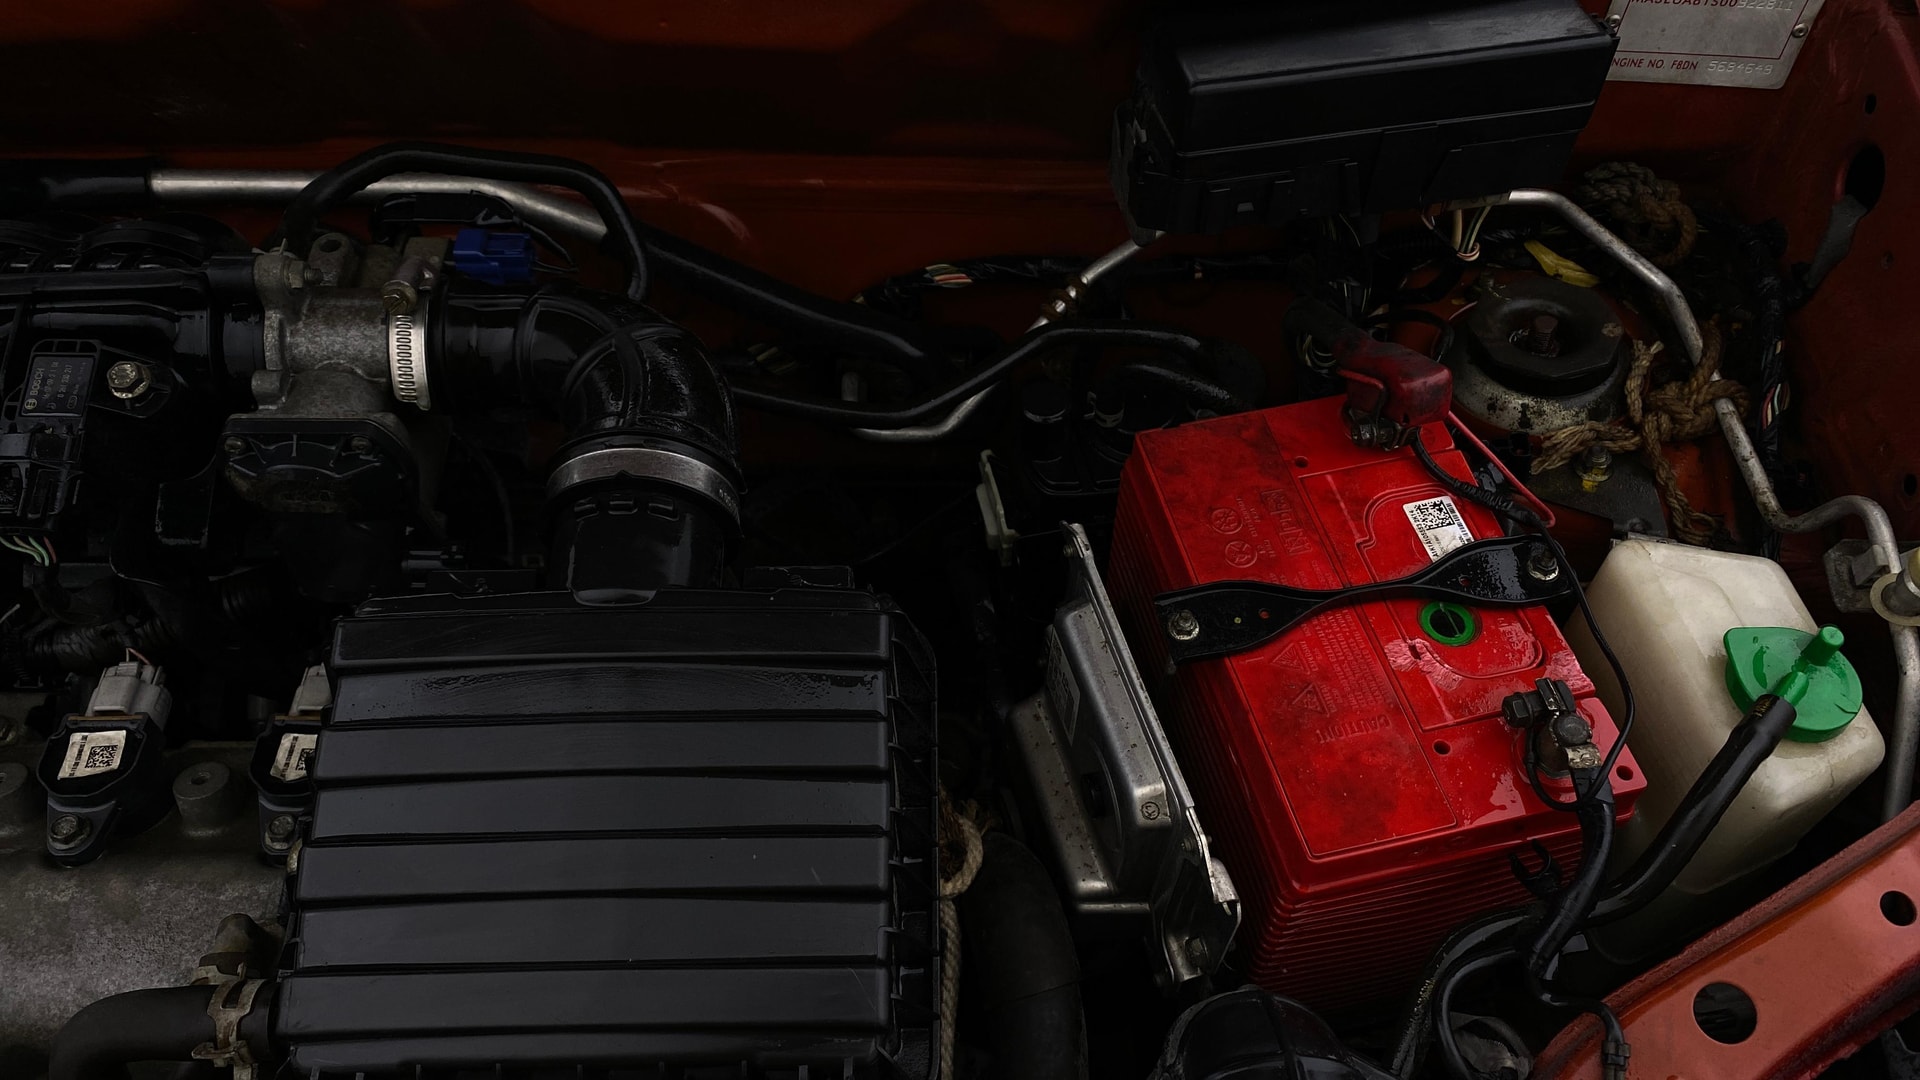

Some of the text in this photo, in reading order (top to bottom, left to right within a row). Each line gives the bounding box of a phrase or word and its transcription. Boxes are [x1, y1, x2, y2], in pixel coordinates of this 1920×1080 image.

[1611, 57, 1644, 68] NGINE
[1647, 59, 1665, 69] NO.
[1670, 60, 1699, 70] F8DN
[30, 368, 45, 396] BOSCH
